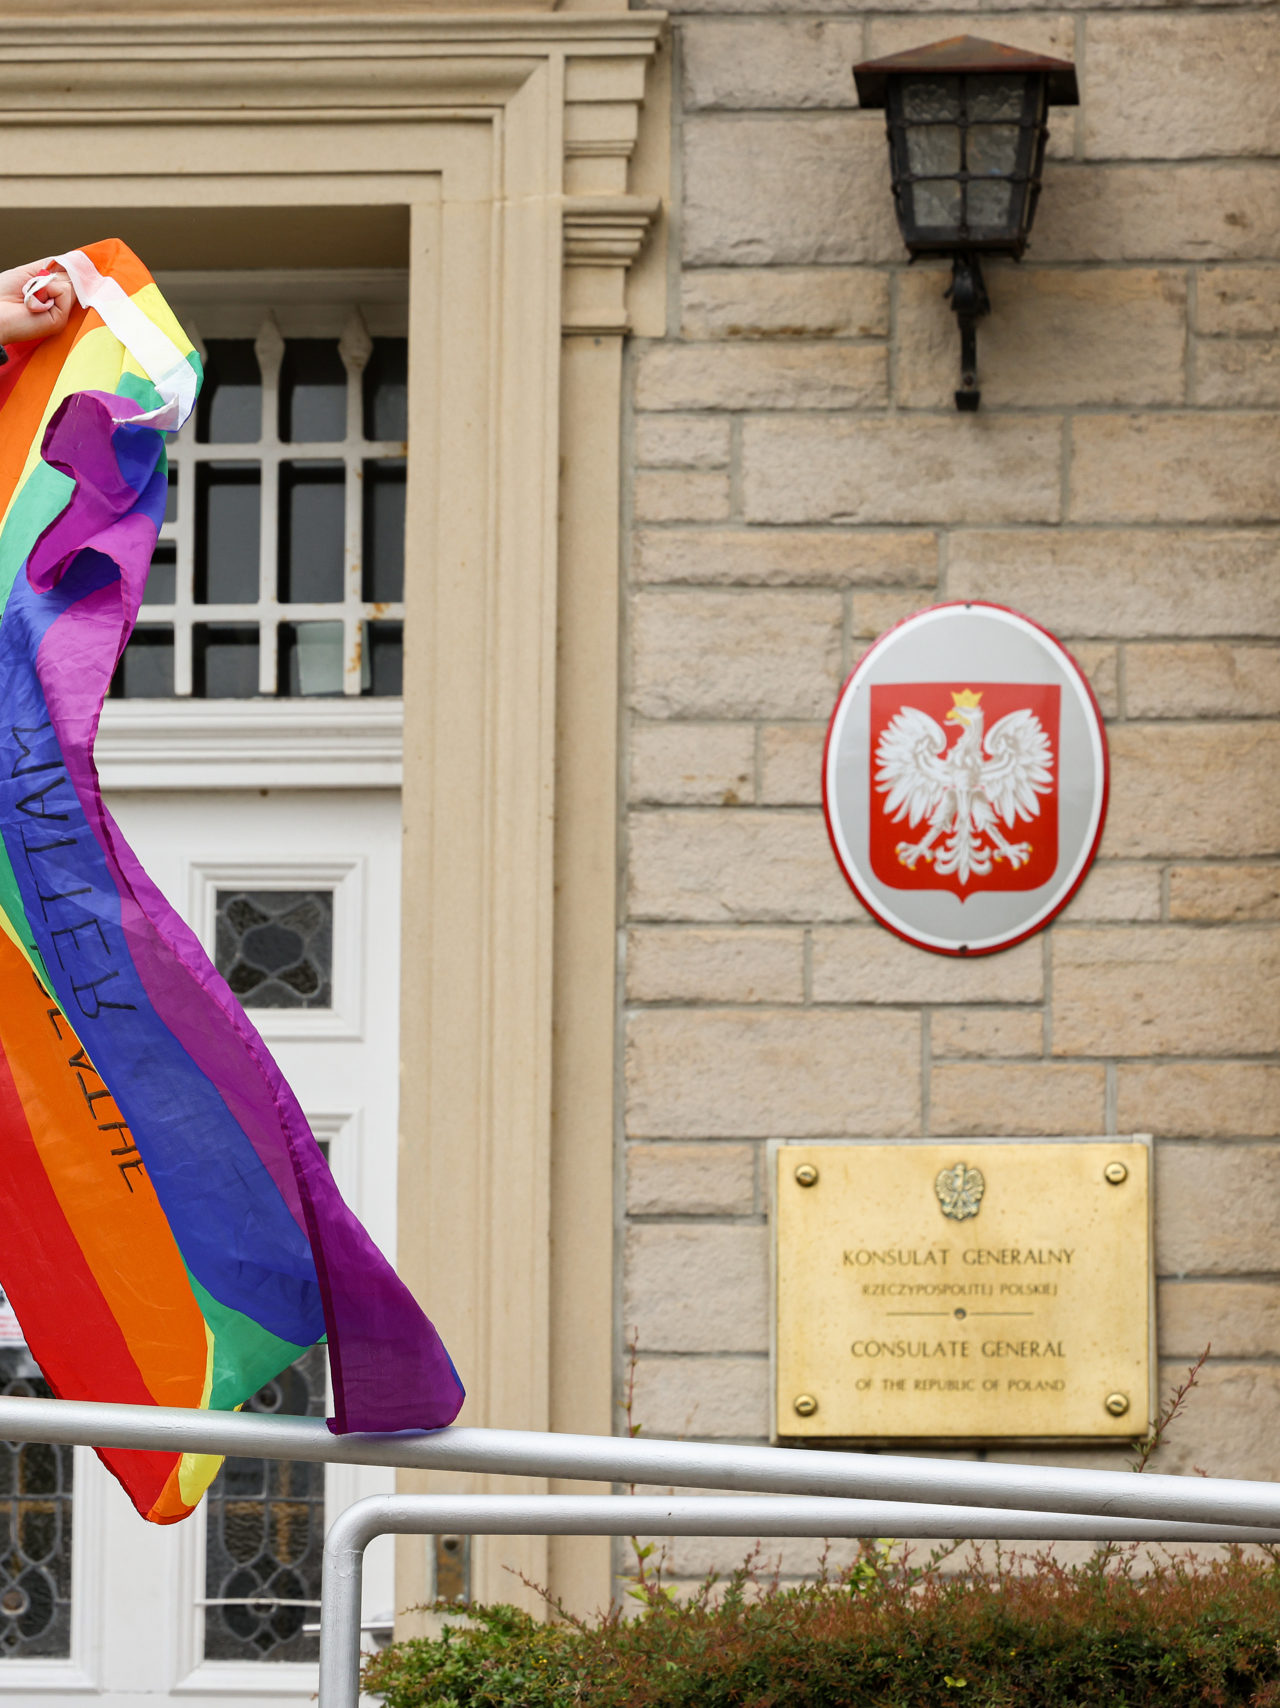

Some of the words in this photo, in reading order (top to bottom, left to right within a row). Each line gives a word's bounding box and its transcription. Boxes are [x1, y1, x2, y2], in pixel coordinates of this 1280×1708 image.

[842, 1249, 951, 1266] KONSULAT
[962, 1248, 1075, 1265] GENERALNY
[862, 1283, 994, 1296] RZECZYPOSPOLITEJ
[1000, 1283, 1058, 1296] POLSKIEJ
[850, 1340, 969, 1358] CONSULATE
[981, 1340, 1066, 1358] GENERAL
[855, 1379, 872, 1392] OF
[883, 1379, 906, 1392] THE
[913, 1379, 975, 1392] REPUBLIC
[982, 1379, 999, 1392] OF
[1007, 1379, 1066, 1392] POLAND
